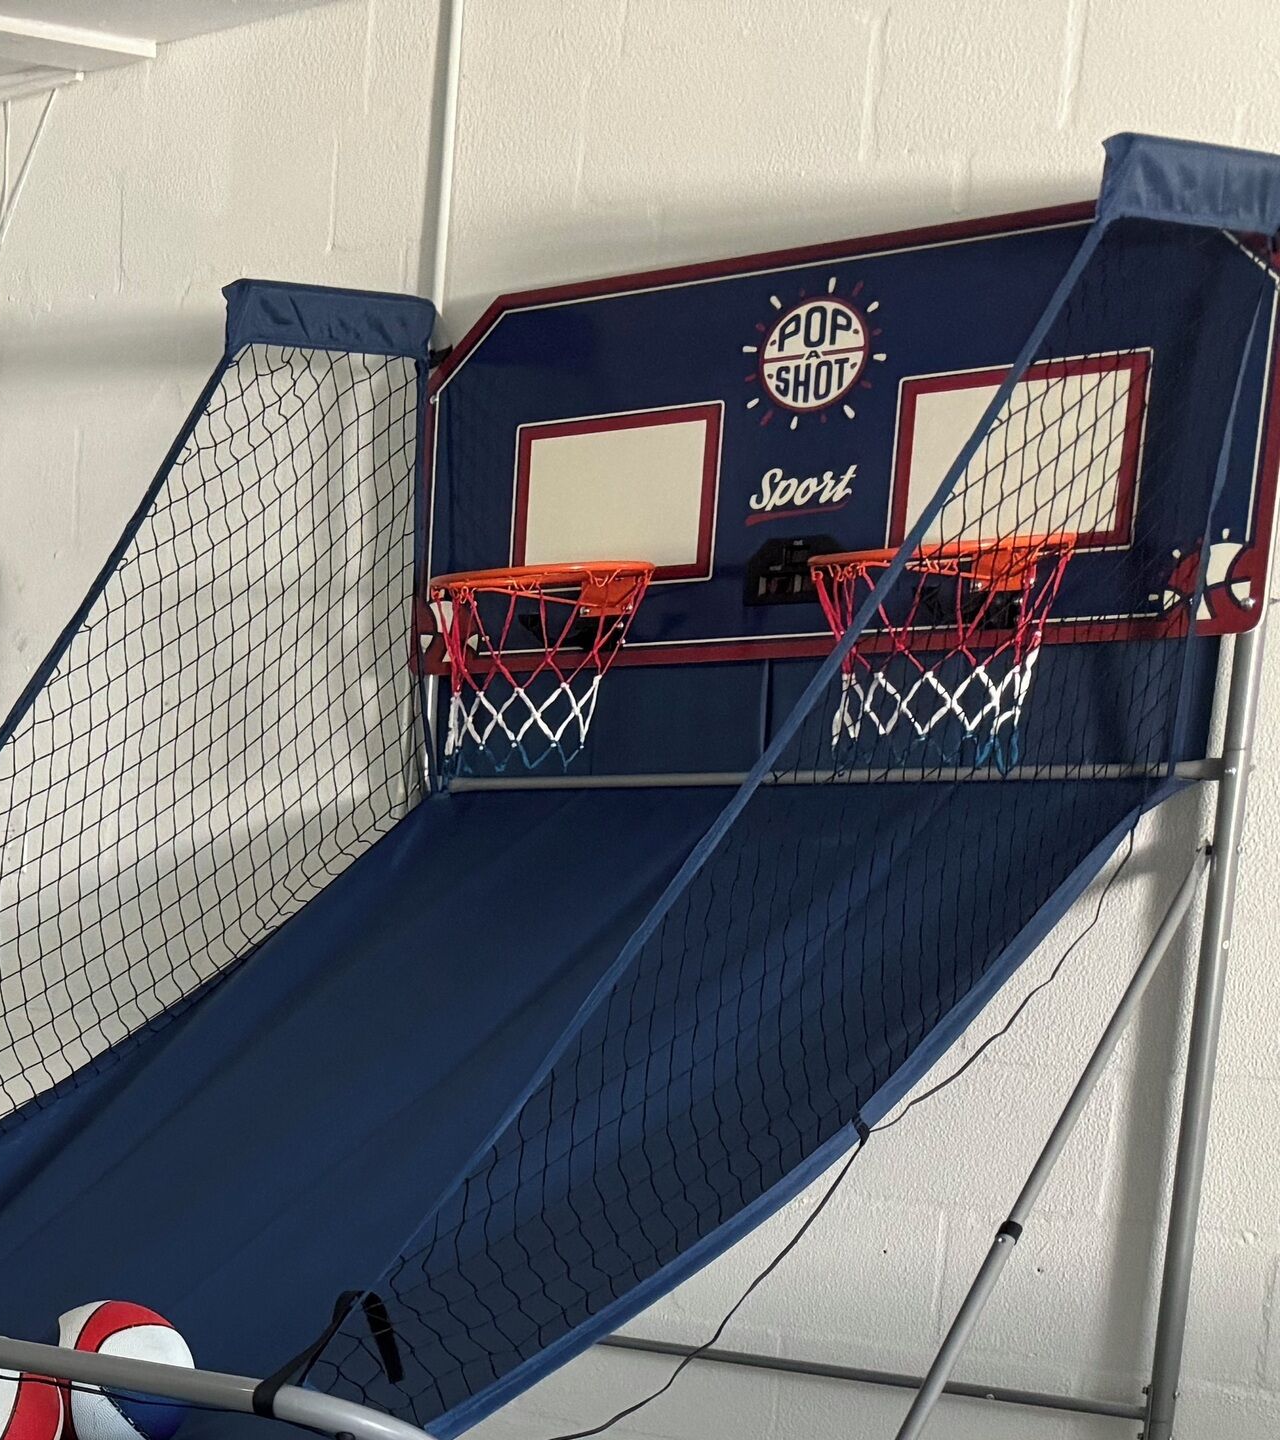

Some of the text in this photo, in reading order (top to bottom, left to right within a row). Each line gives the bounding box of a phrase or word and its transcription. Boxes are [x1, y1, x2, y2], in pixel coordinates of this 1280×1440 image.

[777, 305, 852, 352] POP
[805, 350, 821, 361] A
[775, 357, 850, 403] SHOT
[749, 464, 858, 511] Sport
